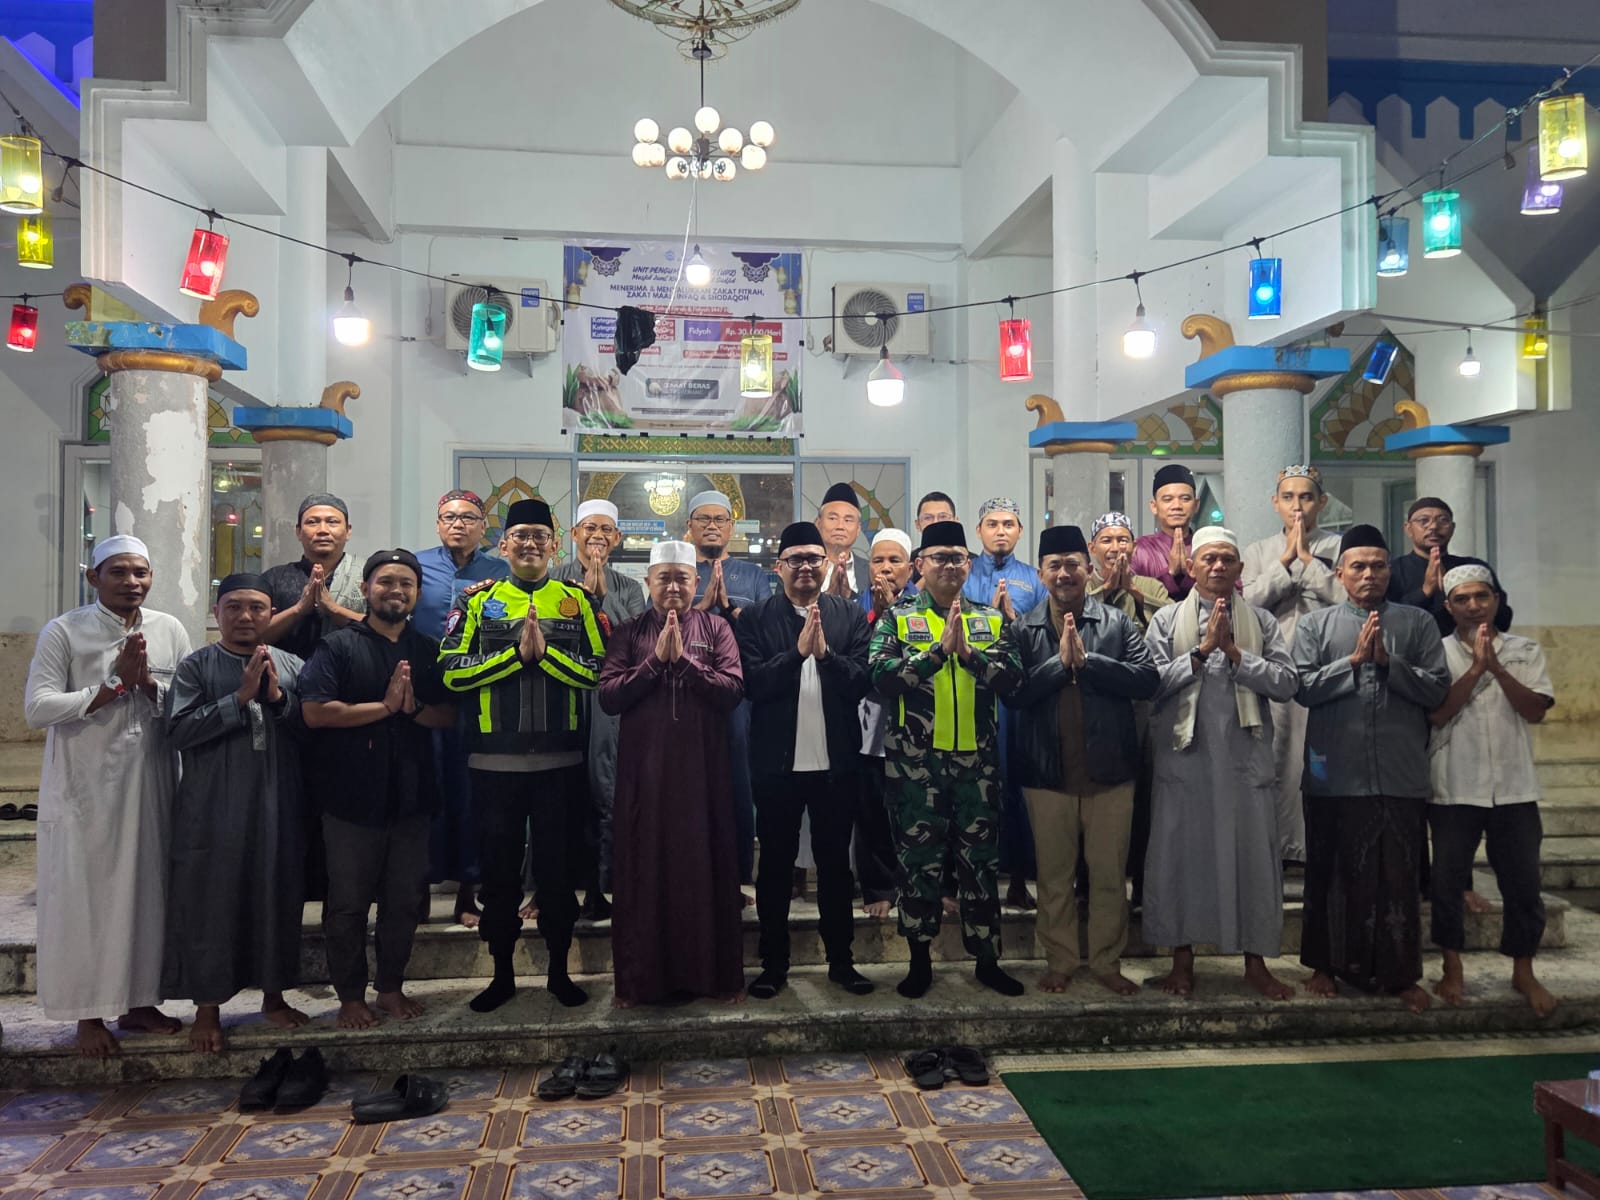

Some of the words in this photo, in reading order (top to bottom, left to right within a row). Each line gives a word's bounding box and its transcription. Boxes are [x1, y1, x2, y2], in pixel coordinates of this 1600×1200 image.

[632, 265, 650, 273] UNIT
[609, 284, 647, 292] MENERIMA
[738, 288, 765, 296] FITRAH,
[626, 291, 651, 299] ZAKAT
[708, 294, 749, 302] SHODAQOH
[688, 327, 711, 336] Fidyah
[687, 382, 711, 390] BERAS
